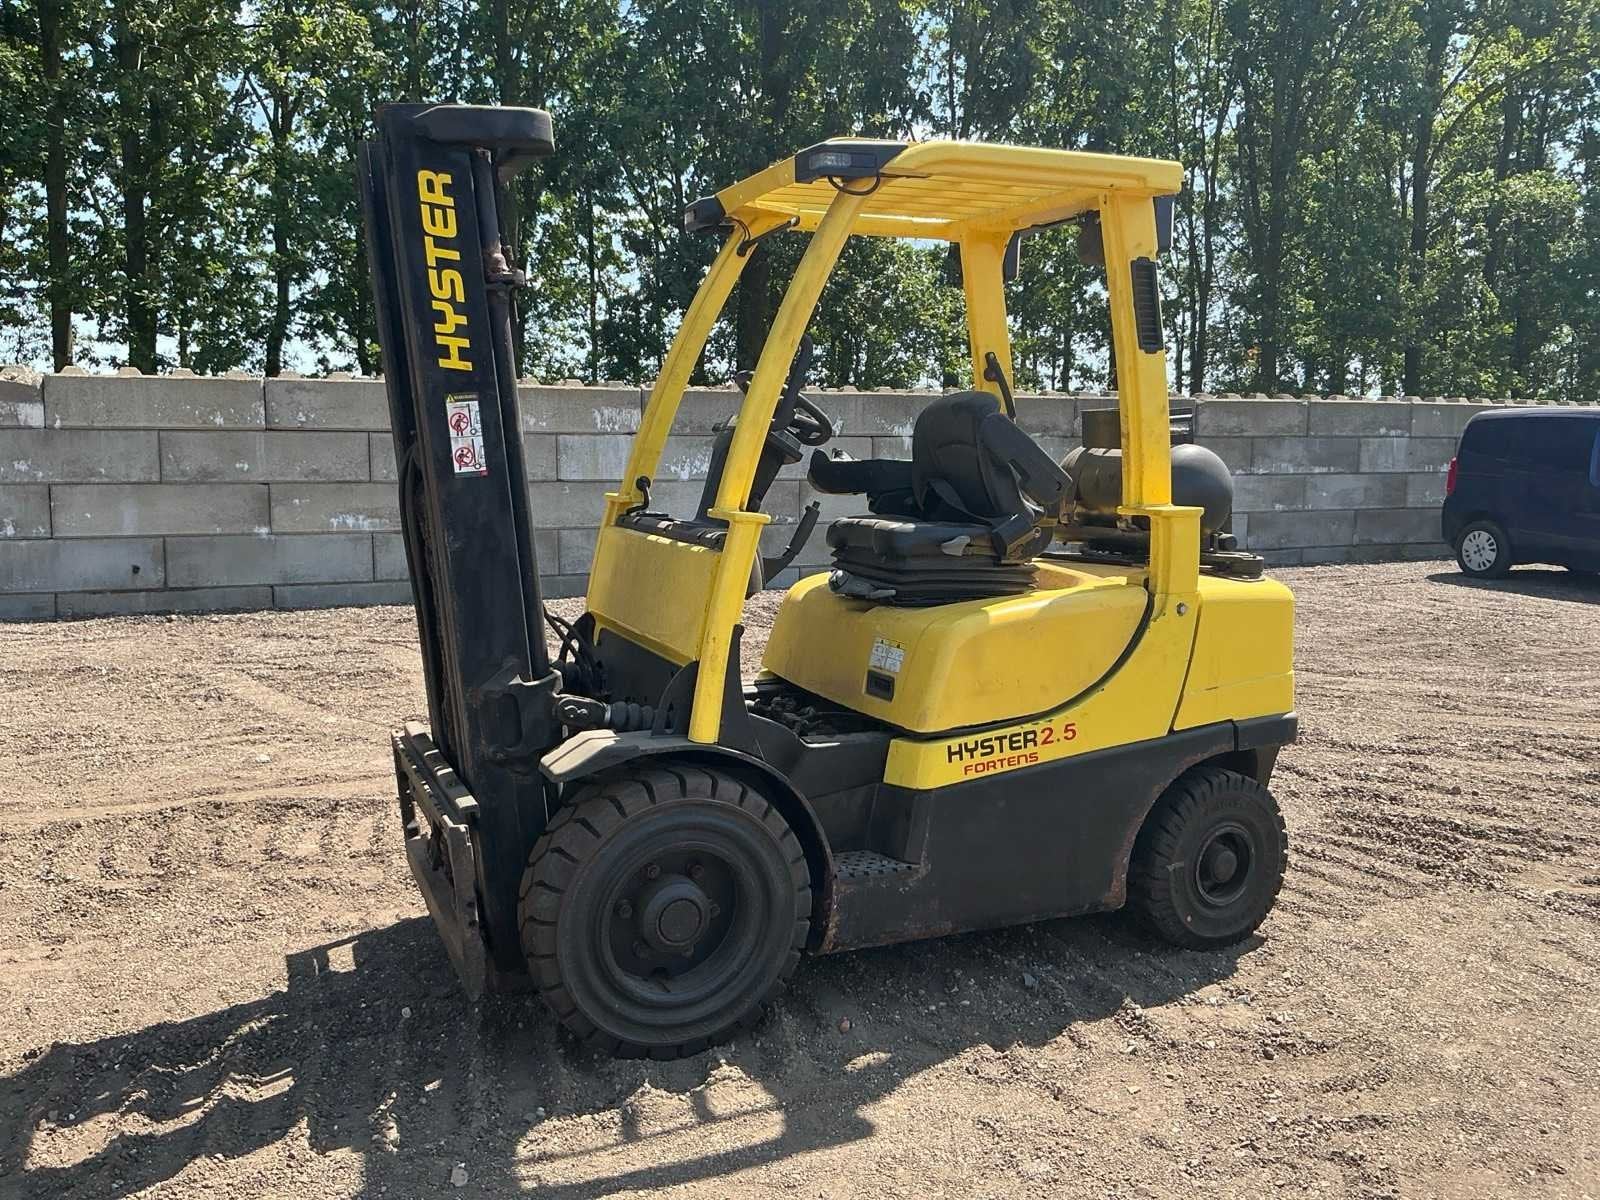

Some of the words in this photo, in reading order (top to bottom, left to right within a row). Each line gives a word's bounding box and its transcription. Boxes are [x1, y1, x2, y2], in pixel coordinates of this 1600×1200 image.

[417, 169, 473, 371] HYSTER
[947, 729, 1038, 763] HYSTER
[1040, 722, 1077, 746] 2.5
[964, 752, 1039, 775] FORTENS
